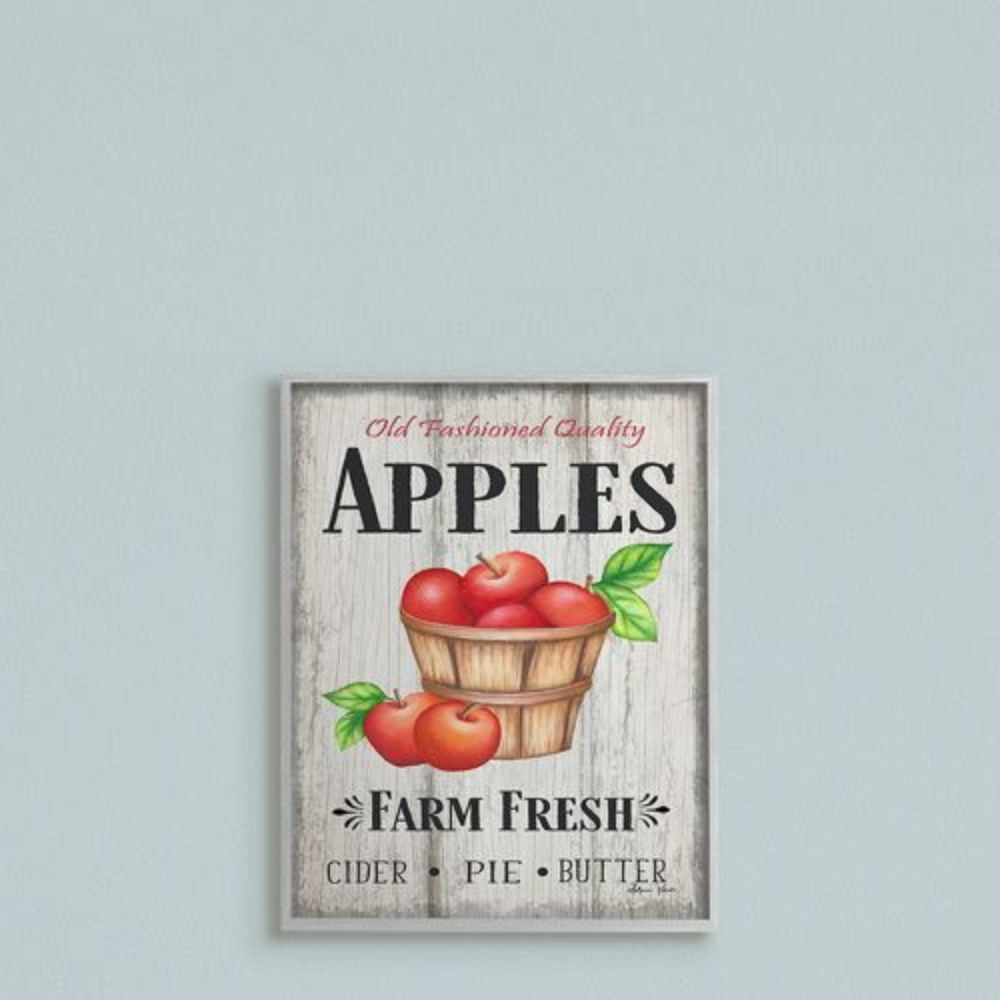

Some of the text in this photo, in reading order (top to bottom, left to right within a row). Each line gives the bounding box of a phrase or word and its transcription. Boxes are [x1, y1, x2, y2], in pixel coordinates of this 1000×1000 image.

[365, 415, 646, 448] Old Fashioned Quality
[322, 447, 678, 534] APPLES
[368, 790, 635, 832] FARM FRESH
[326, 857, 667, 885] CIDER PIE BUTTER
